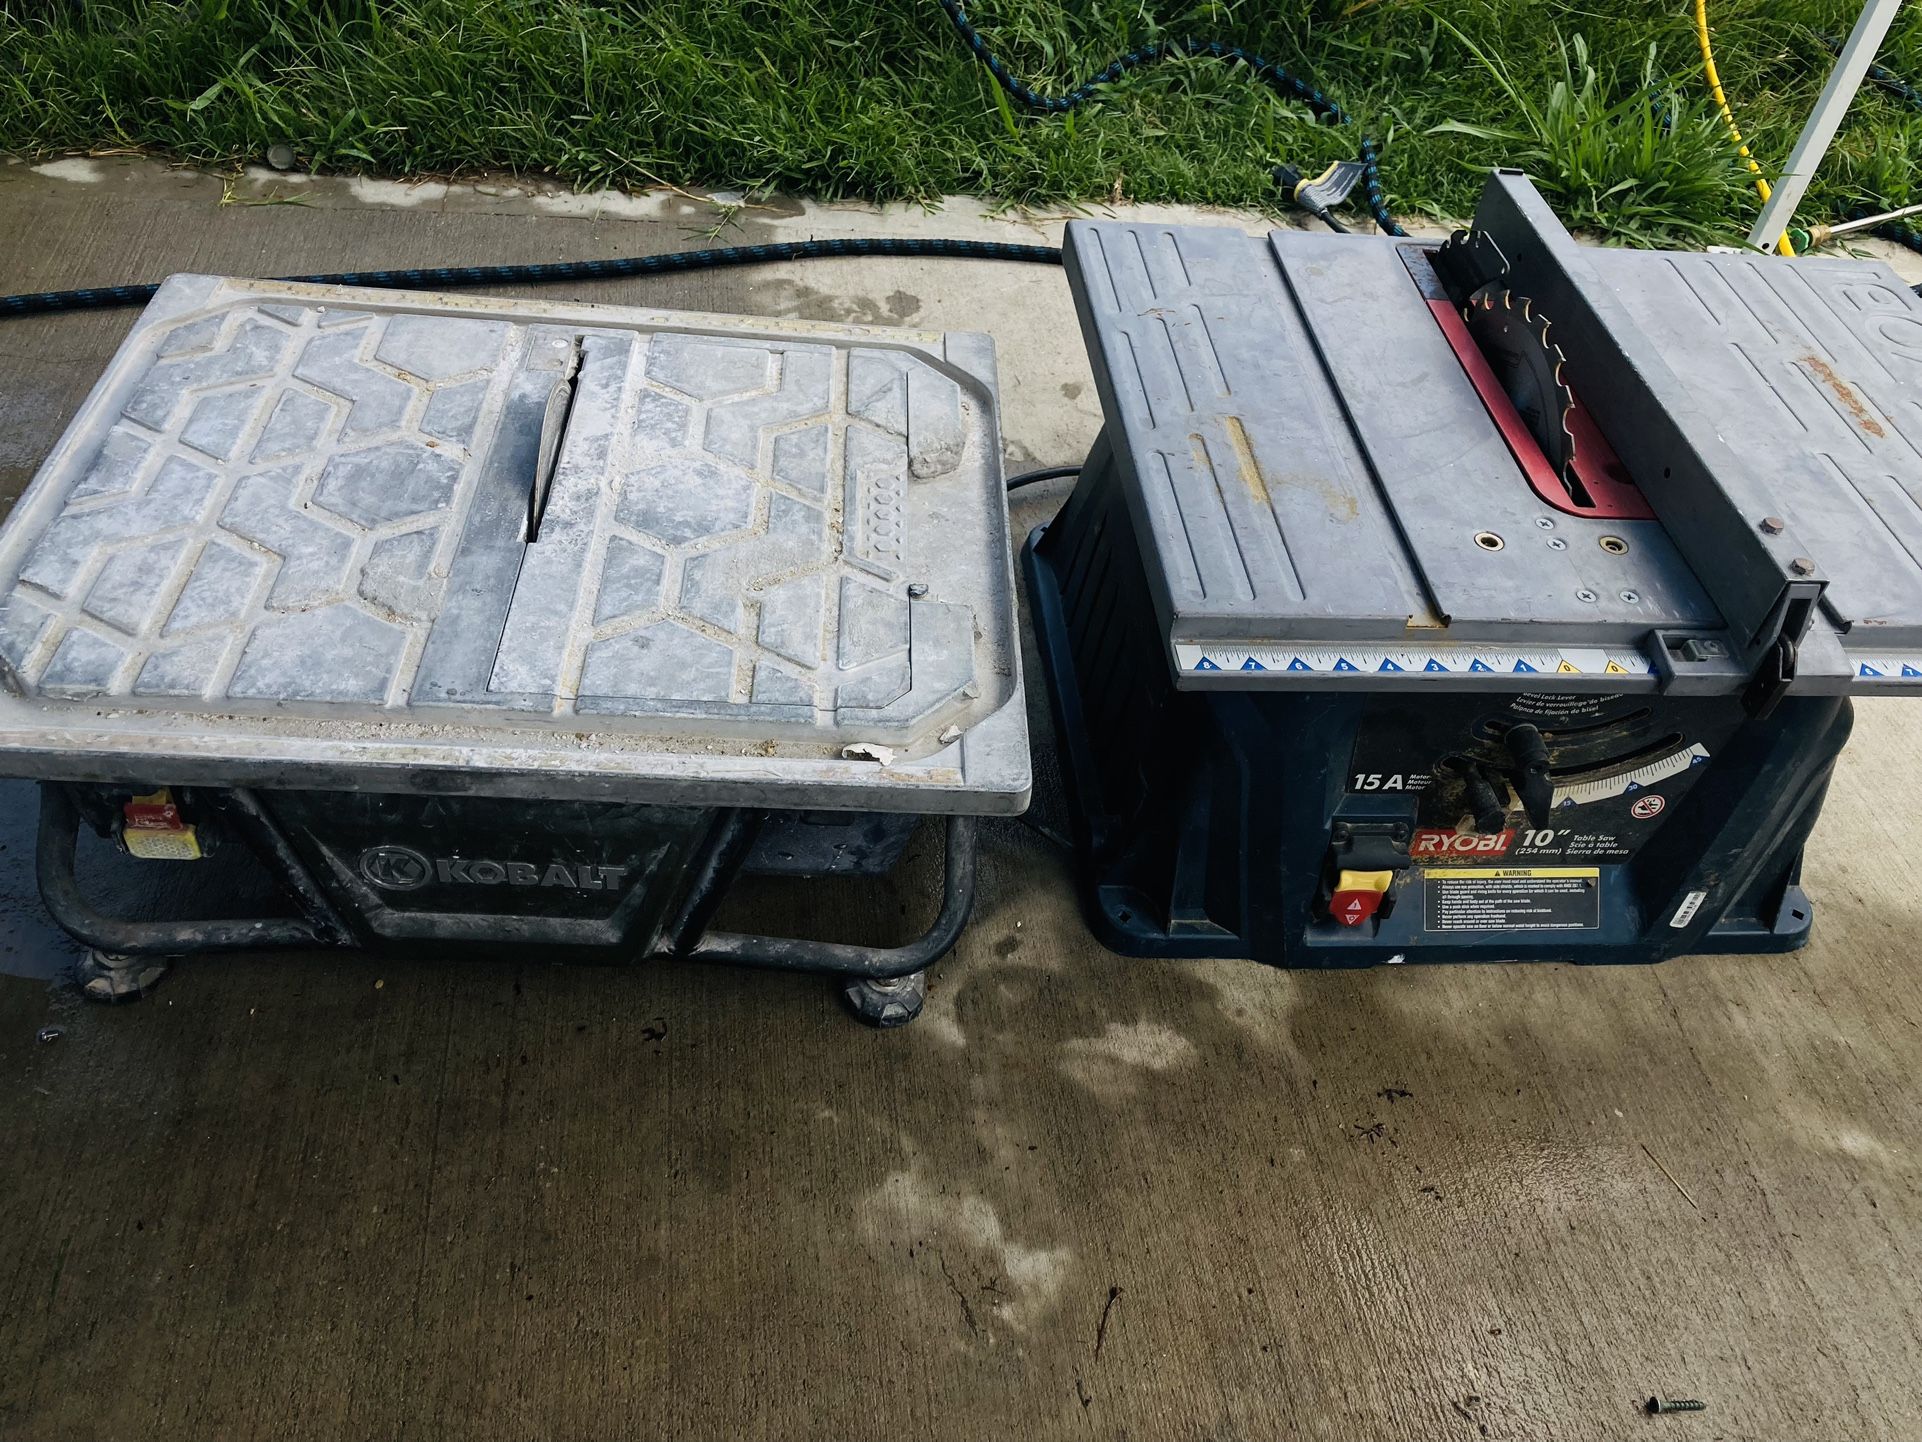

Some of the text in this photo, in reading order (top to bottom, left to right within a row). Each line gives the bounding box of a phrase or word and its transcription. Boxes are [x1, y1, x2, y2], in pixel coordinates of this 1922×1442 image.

[1386, 662, 1394, 670] 4
[1905, 668, 1913, 676] 7
[1516, 697, 1536, 705] Levier
[1354, 773, 1403, 790] 15 A
[1628, 784, 1638, 792] 30
[1418, 834, 1507, 851] RYOBI
[1515, 847, 1562, 856] (254 mm)
[436, 858, 628, 890] KOBALT
[1502, 869, 1532, 877] WARNING
